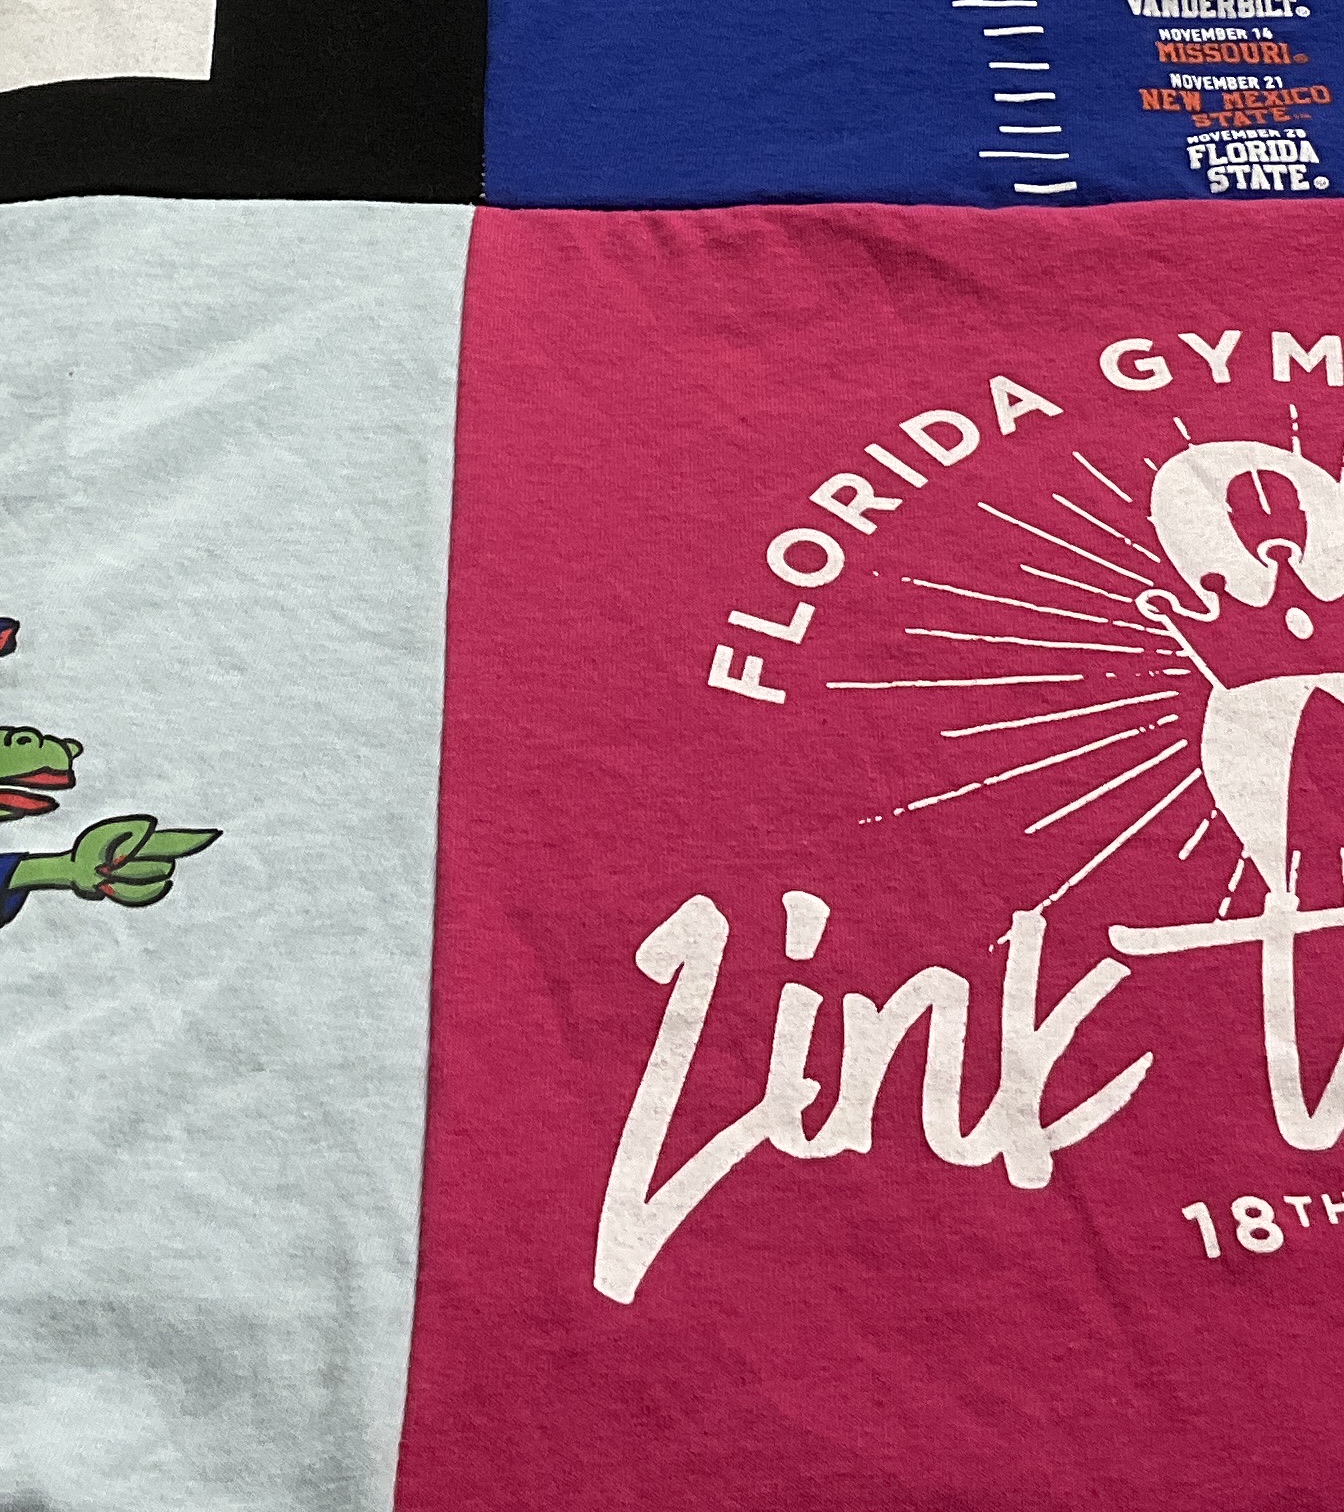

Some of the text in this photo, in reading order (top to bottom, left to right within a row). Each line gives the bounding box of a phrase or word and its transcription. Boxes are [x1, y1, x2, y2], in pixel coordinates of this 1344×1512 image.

[1158, 26, 1274, 43] NOVEMBER 14
[1154, 40, 1292, 65] MISSOURI
[1169, 72, 1285, 91] NOVEMBER 21
[1138, 84, 1334, 112] NEW MEXICO
[1190, 106, 1292, 128] STATE
[1186, 128, 1282, 145] NOVEMBER
[1186, 139, 1321, 171] FLORIDA
[1206, 163, 1311, 194] STATE
[704, 371, 1066, 709] FLORIDA
[590, 889, 1158, 1307] Link
